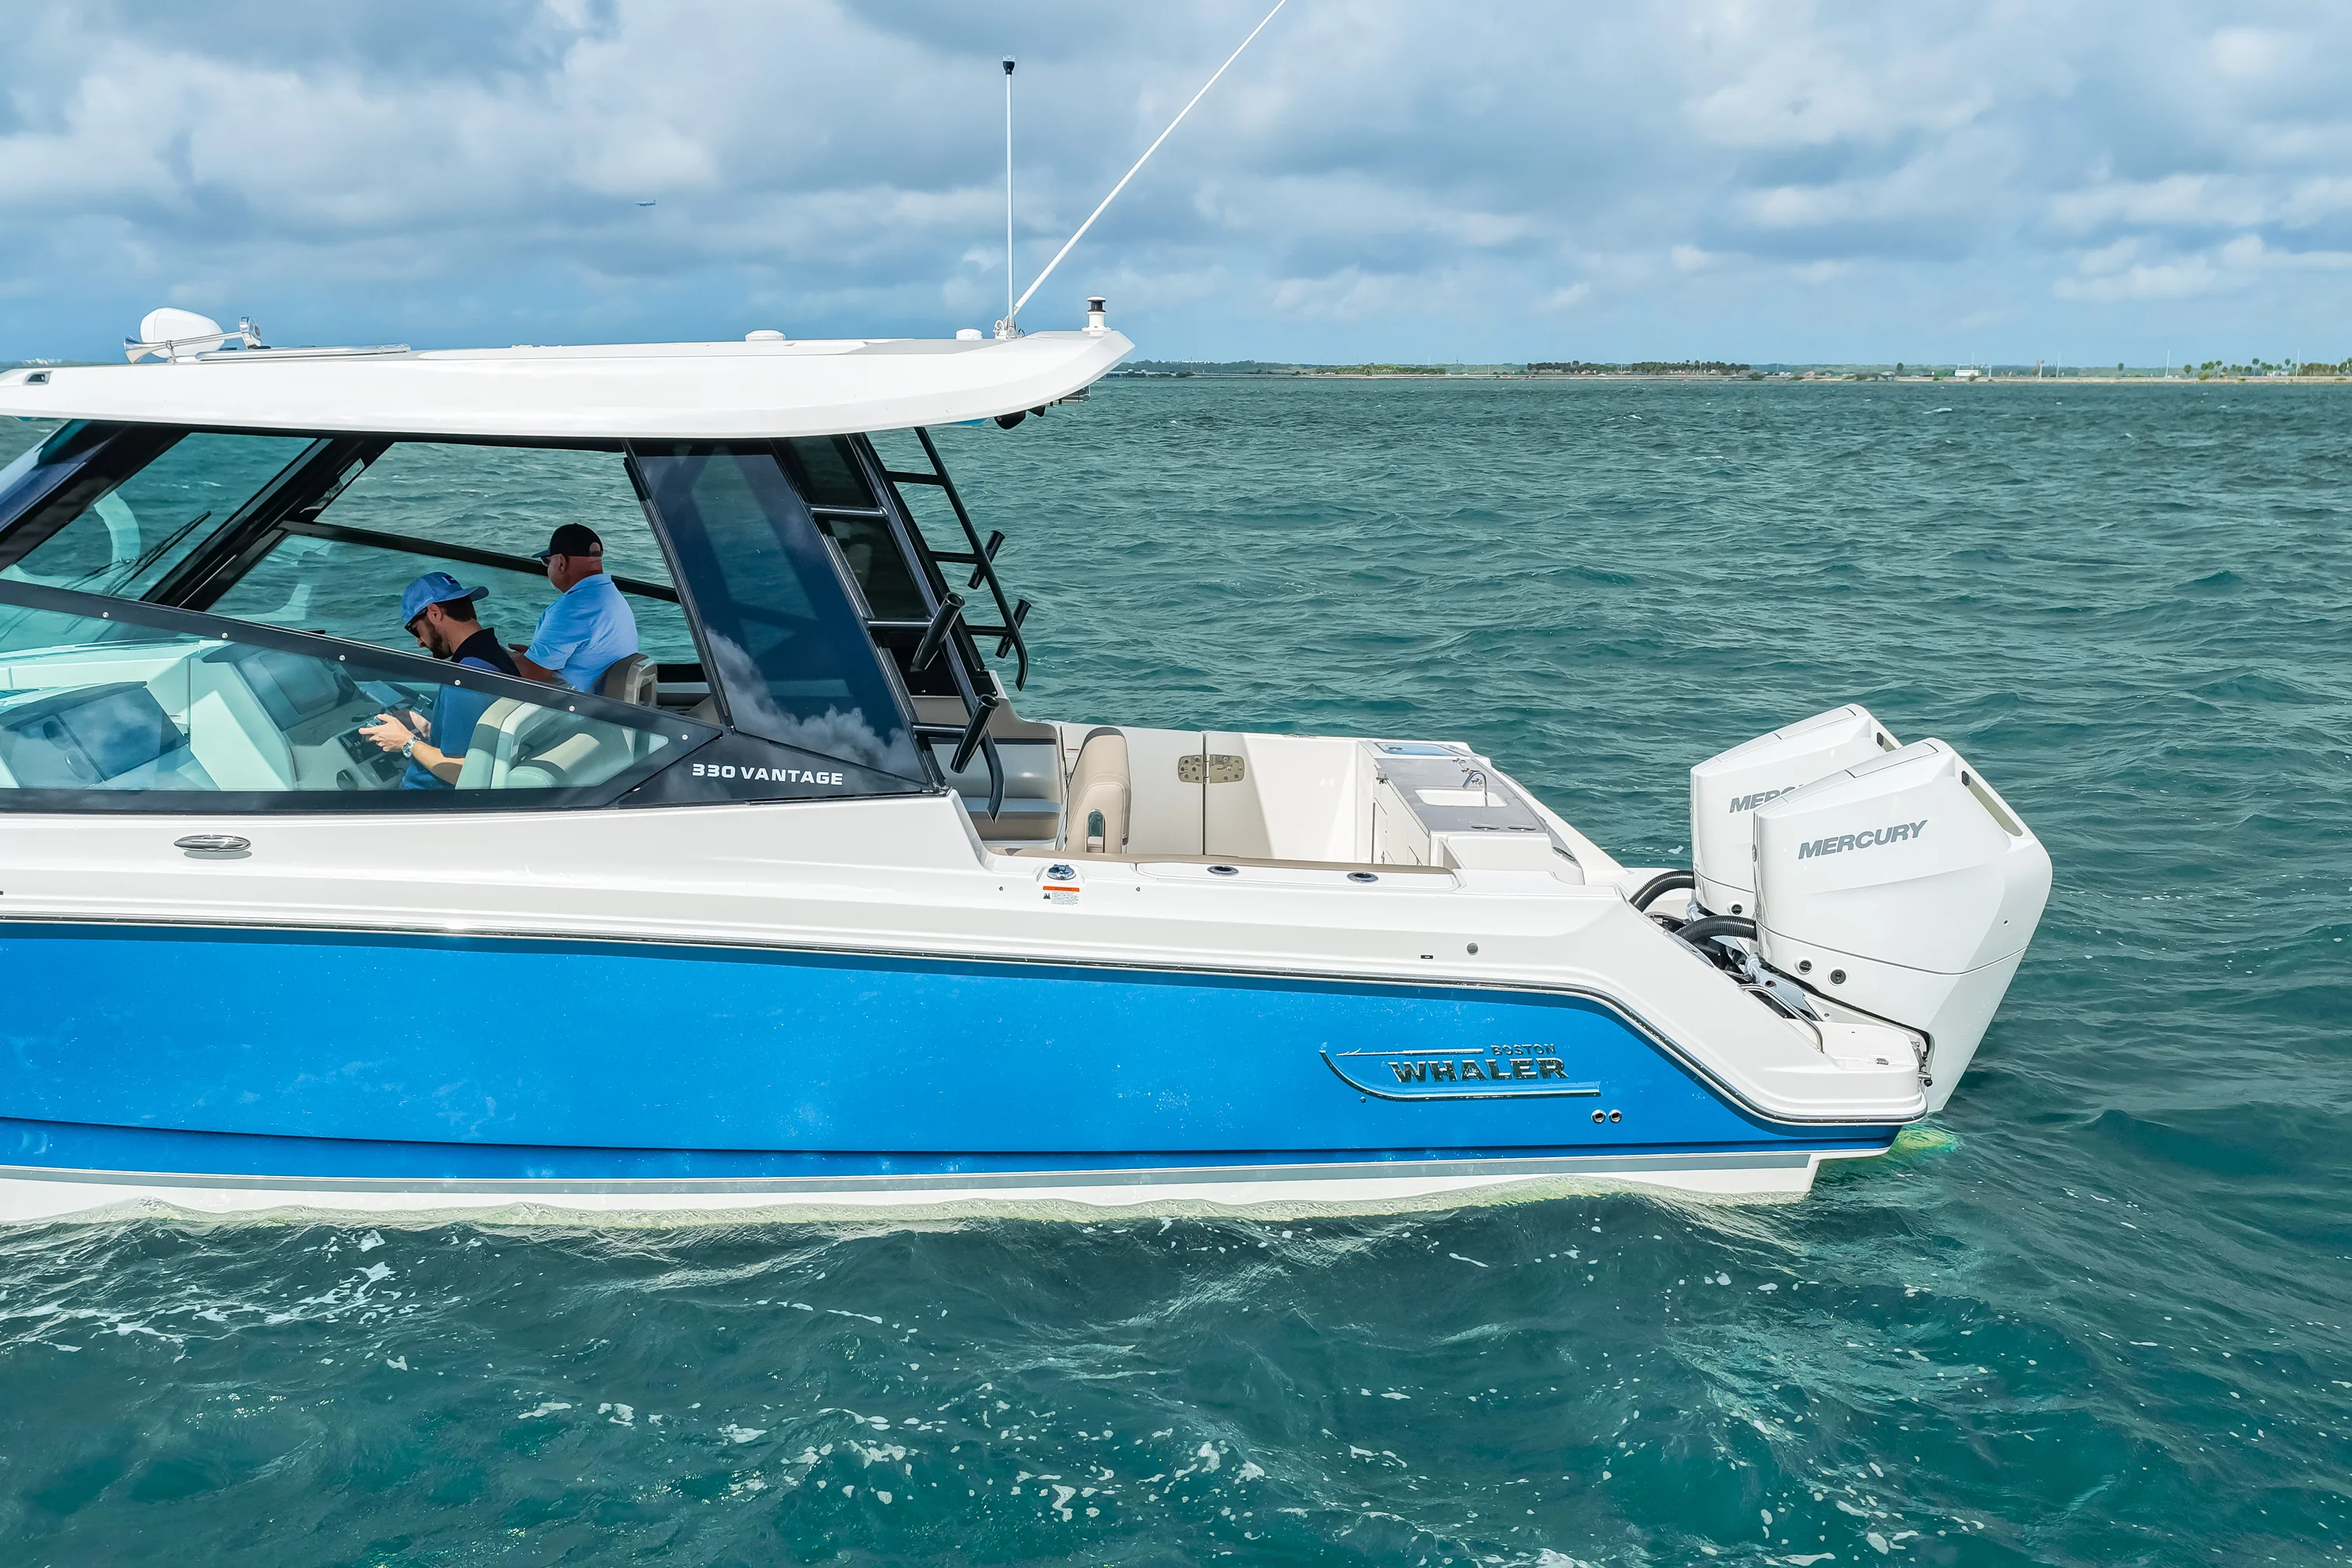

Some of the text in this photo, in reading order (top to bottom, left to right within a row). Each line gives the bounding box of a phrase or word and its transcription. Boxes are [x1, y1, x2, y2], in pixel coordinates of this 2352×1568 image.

[691, 763, 844, 786] 330 VANTAGE
[1729, 784, 1803, 814] MER
[1798, 819, 1929, 860] MERCURY
[1490, 1043, 1557, 1056] BOSTON
[1387, 1056, 1570, 1083] WHALER
